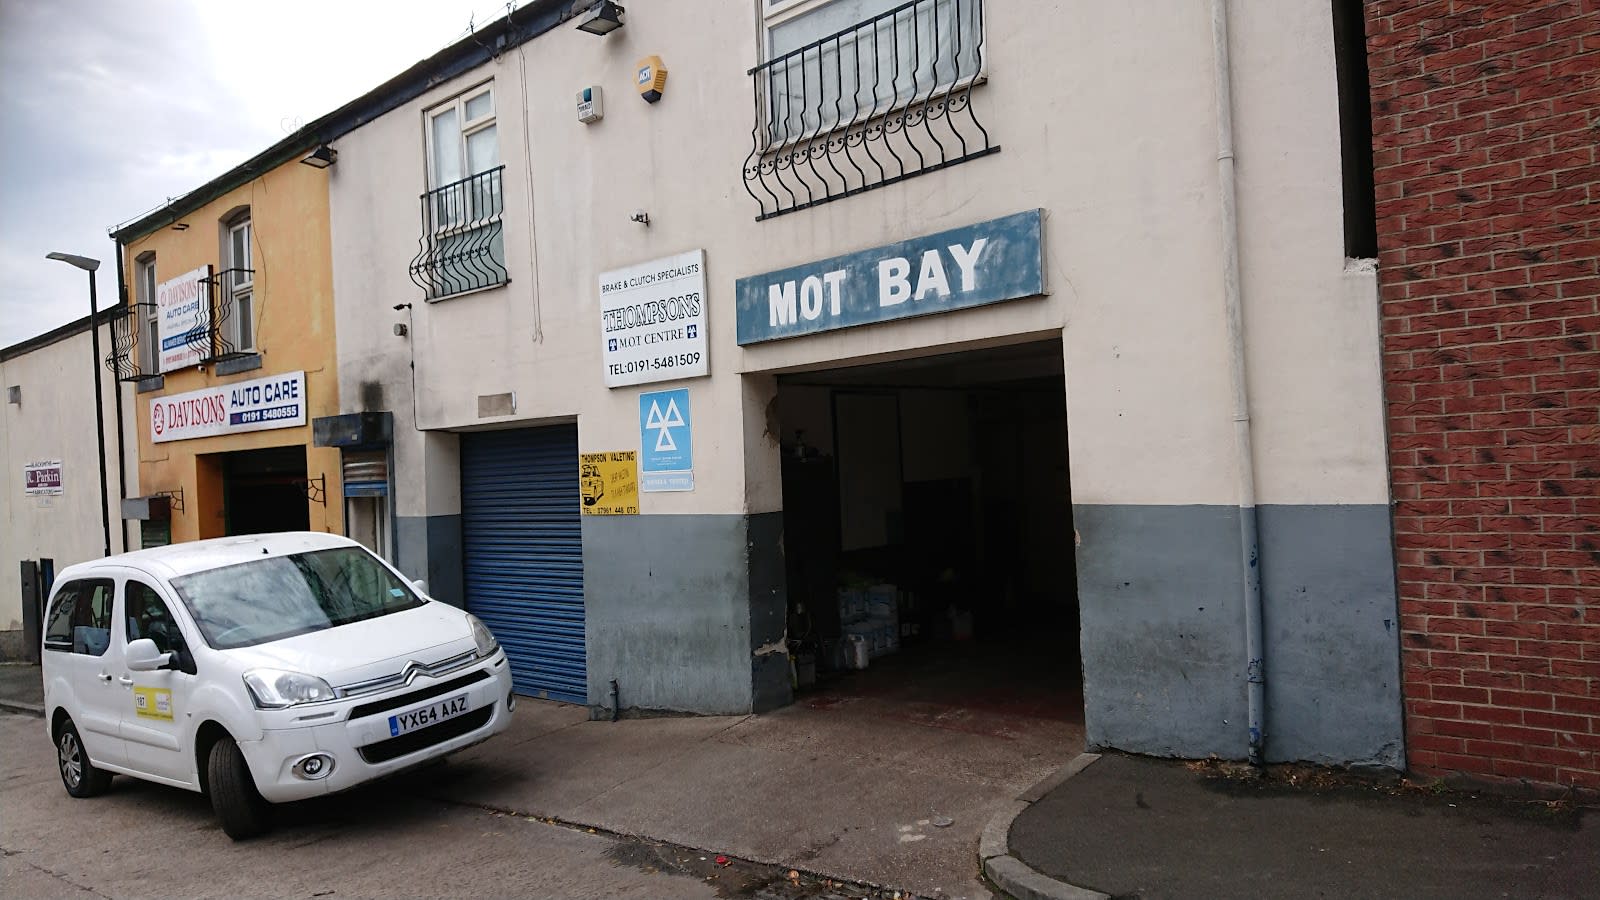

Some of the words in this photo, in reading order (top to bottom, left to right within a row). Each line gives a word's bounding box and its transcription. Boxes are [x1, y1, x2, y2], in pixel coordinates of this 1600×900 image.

[639, 69, 651, 81] ADT
[602, 281, 622, 293] BRAKE
[623, 280, 628, 289] &
[629, 273, 656, 288] CLUTCH
[657, 263, 699, 282] SPECIALISTS
[768, 269, 846, 328] MOT
[878, 237, 989, 308] BAY
[168, 279, 197, 305] DAVISONS
[166, 307, 182, 319] AUTO
[182, 300, 199, 315] CARE
[603, 292, 701, 332] THOMPSONS
[644, 328, 684, 345] CENTRE
[608, 352, 701, 376] TEL:0191-5481509
[231, 385, 261, 408] AUTO
[265, 379, 298, 403] CARE
[168, 394, 225, 429] DAVISONS
[242, 411, 261, 423] 0191
[262, 406, 297, 420] 5480555
[581, 453, 607, 463] THOMPSON
[610, 451, 635, 462] VALETING
[26, 471, 34, 484] R.
[36, 469, 59, 483] Parkin
[399, 707, 437, 730] YX64
[442, 697, 467, 717] AAZ
